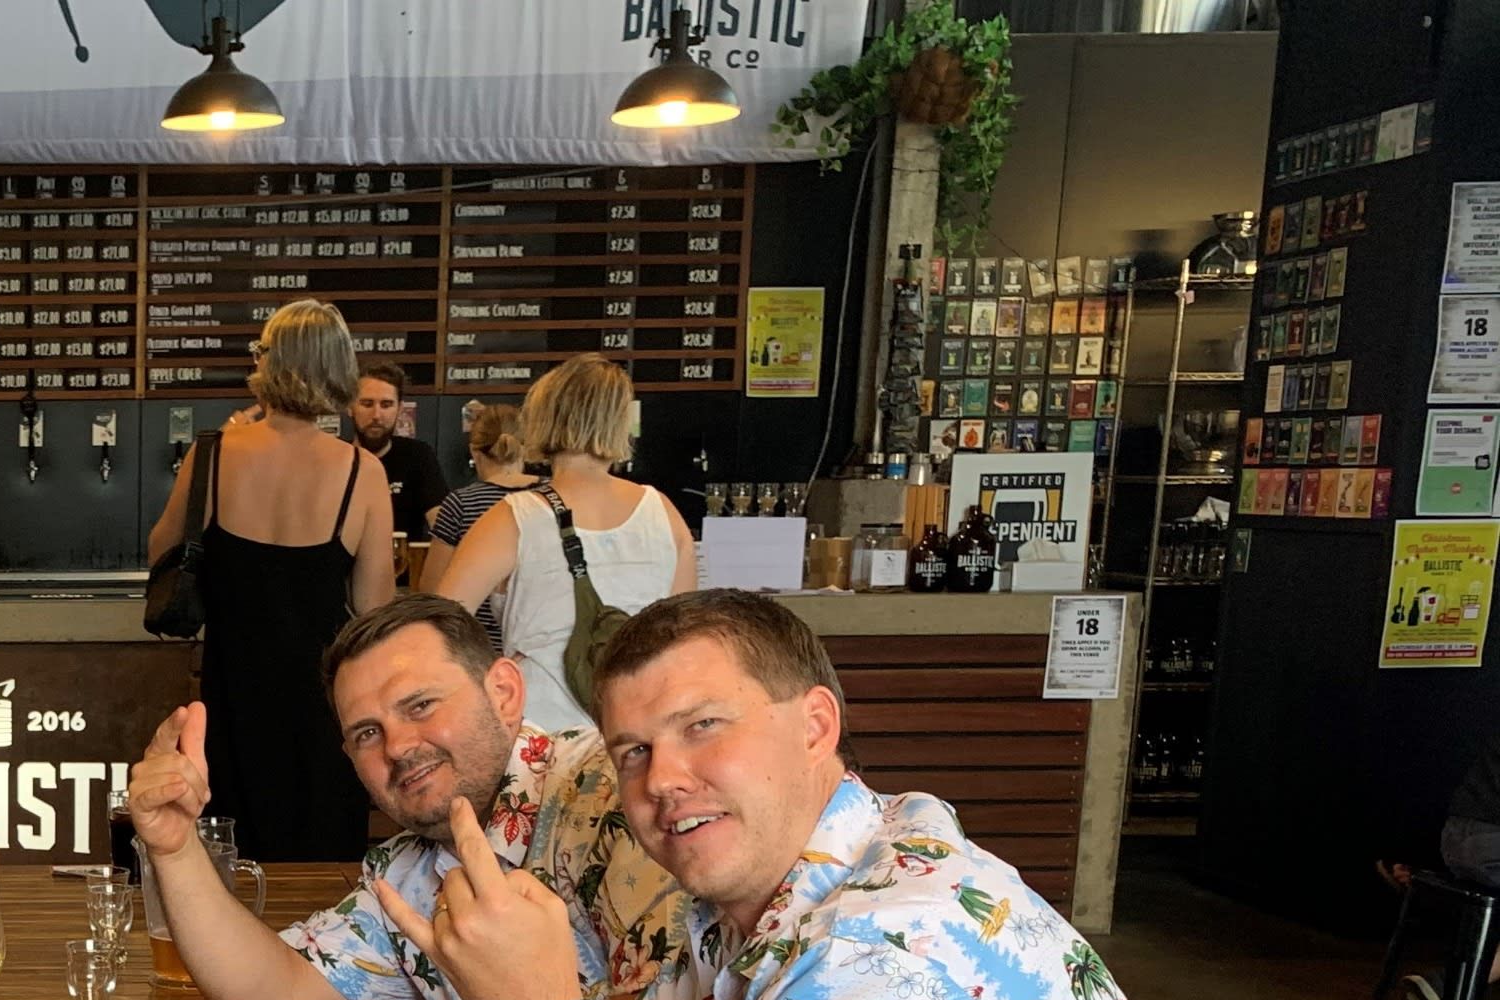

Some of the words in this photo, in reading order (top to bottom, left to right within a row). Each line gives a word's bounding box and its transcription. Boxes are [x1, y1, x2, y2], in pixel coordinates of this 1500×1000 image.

[622, 0, 805, 47] BAISTIC
[611, 205, 636, 219] $7.50
[610, 238, 635, 252] $7.50
[609, 271, 633, 284] $7.50
[606, 302, 631, 316] $7.50
[1464, 317, 1488, 337] 18
[604, 334, 628, 347] $7.50
[982, 474, 1063, 486] CERTIFIED
[996, 521, 1076, 541] PENDENT
[1423, 560, 1463, 572] BALLISTIC
[1076, 617, 1099, 635] 18
[27, 710, 86, 732] 2016
